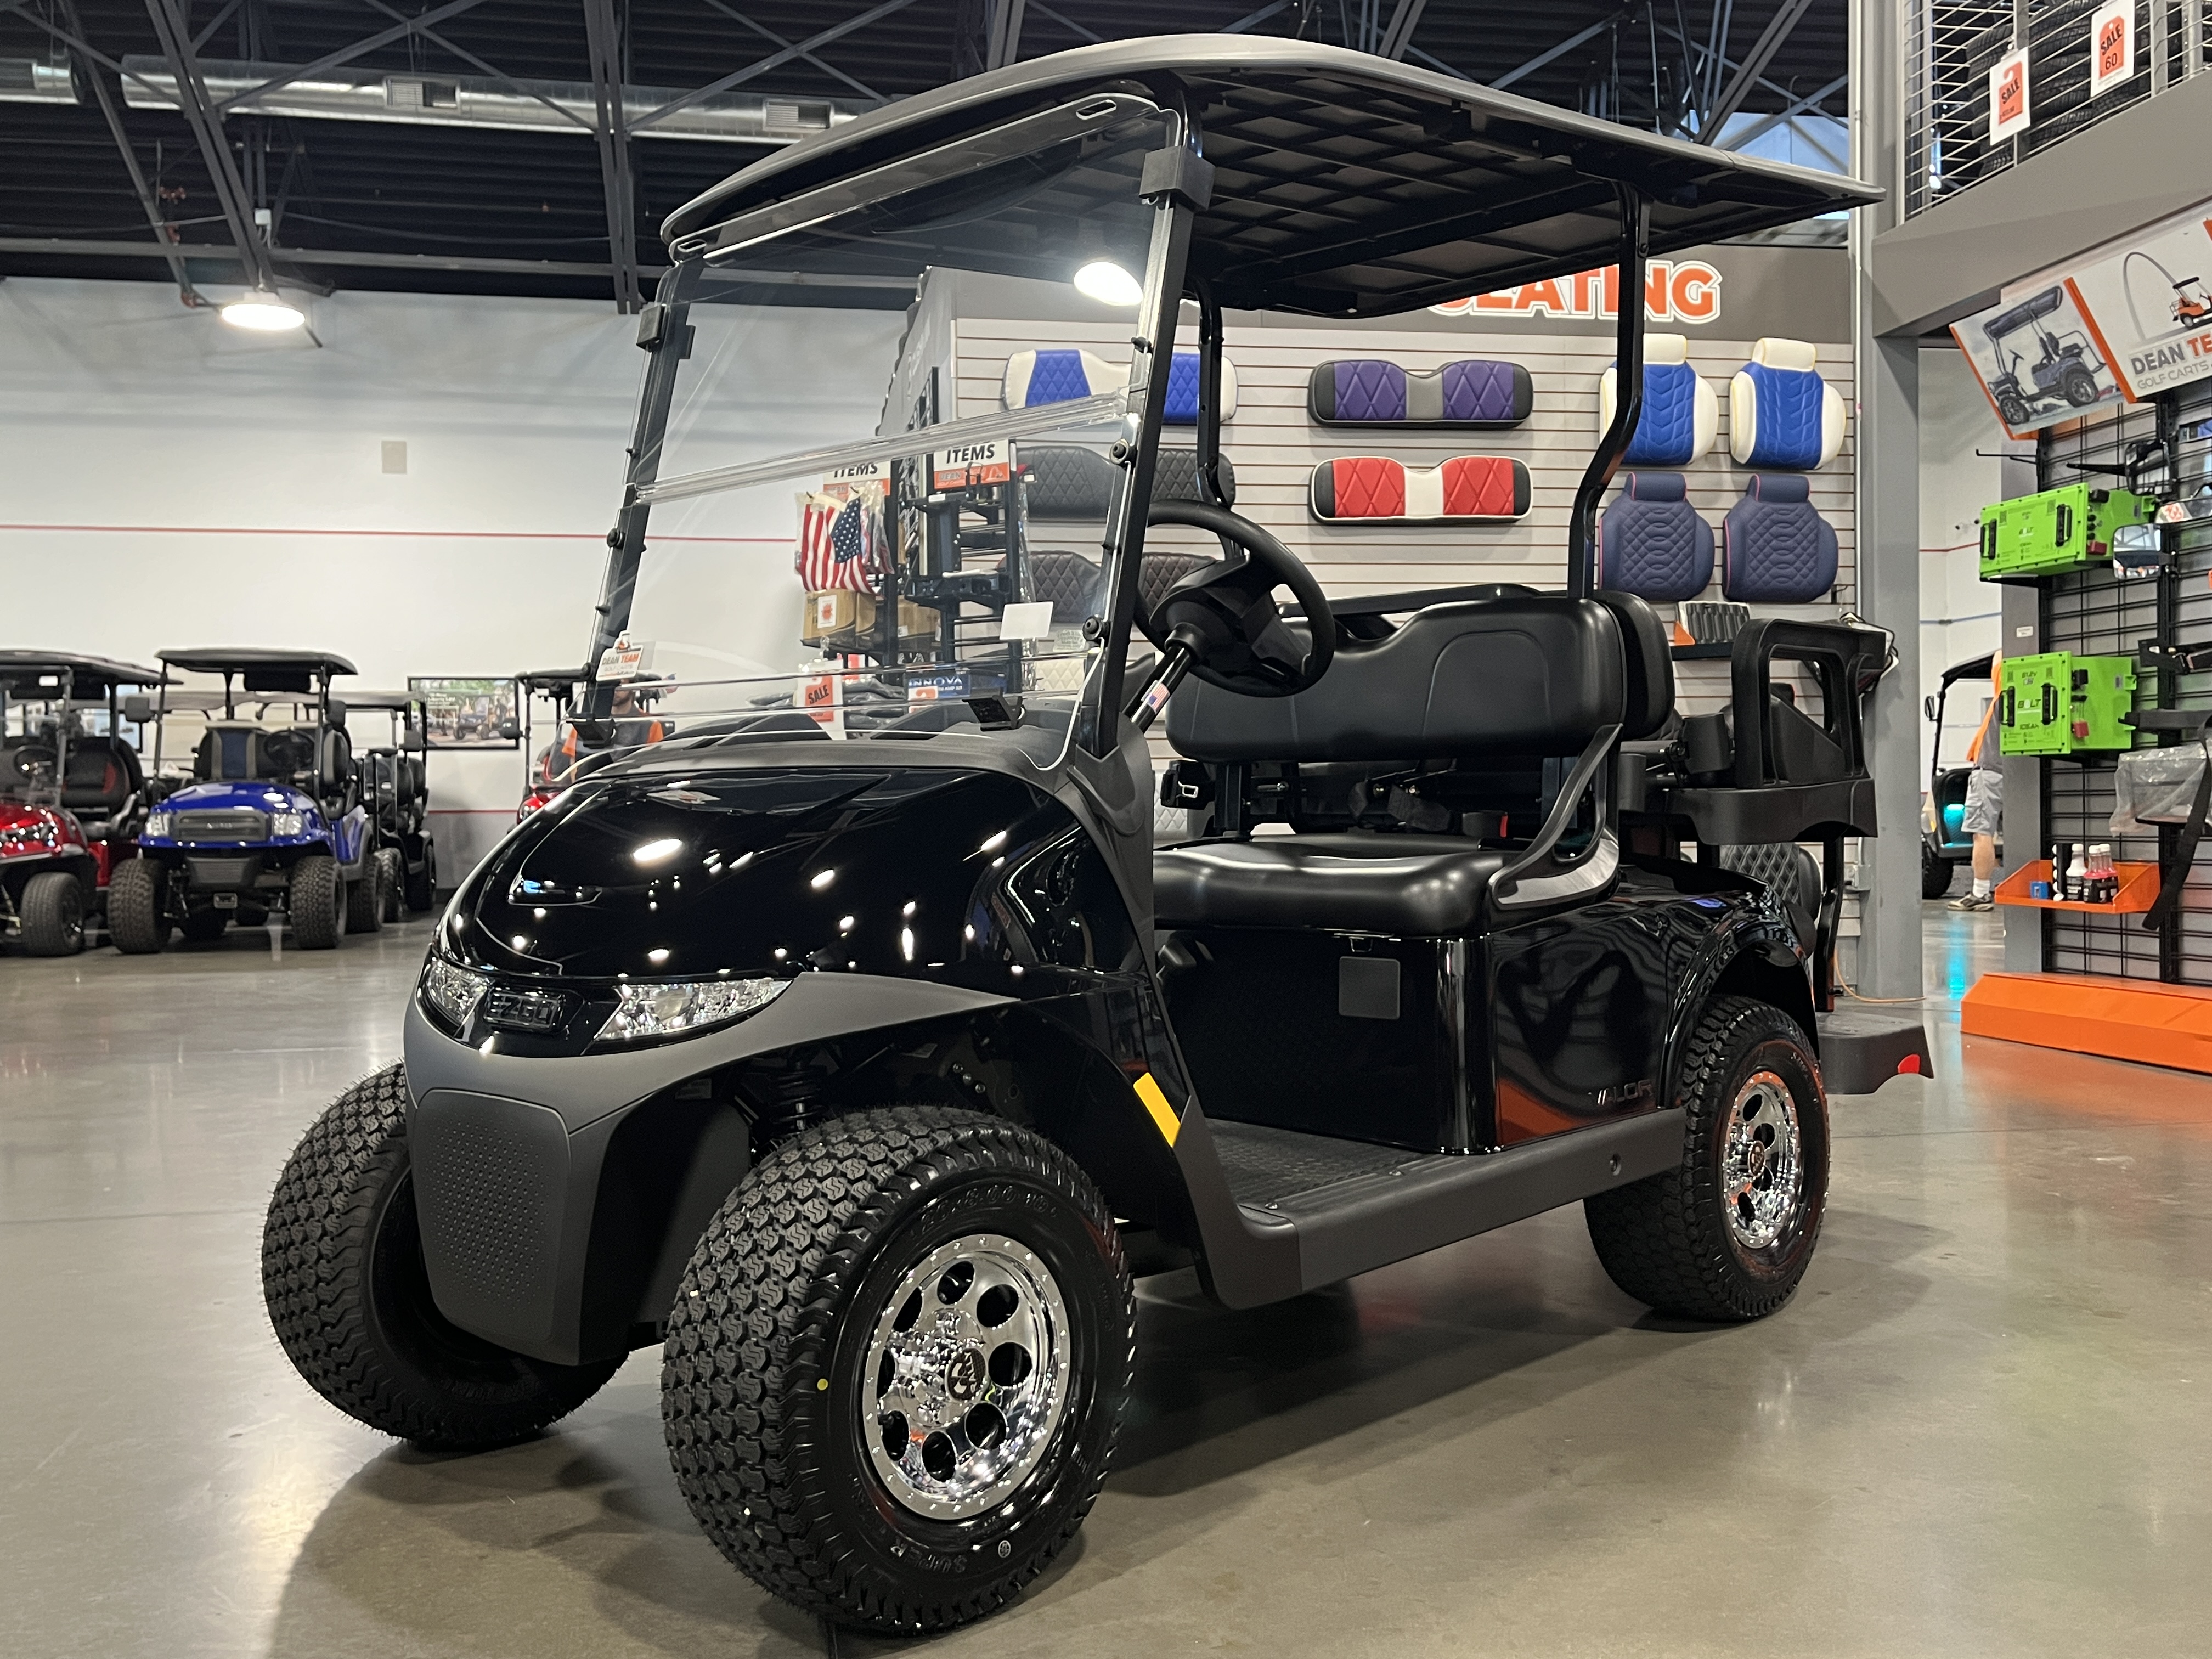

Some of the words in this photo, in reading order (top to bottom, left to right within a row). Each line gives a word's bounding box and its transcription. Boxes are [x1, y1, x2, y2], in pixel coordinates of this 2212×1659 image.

[2101, 24, 2122, 55] SALE
[2001, 78, 2021, 104] SALE
[1431, 261, 1722, 323] ATING
[2131, 344, 2185, 375] DEAN
[2137, 374, 2166, 389] GOLF
[2168, 360, 2209, 380] CARTS
[946, 444, 995, 464] ITEMS
[602, 656, 619, 665] DEAN
[621, 653, 639, 663] TEAM
[808, 685, 829, 704] SALE
[2018, 699, 2041, 708] BOLT
[964, 1352, 977, 1393] RALLY
